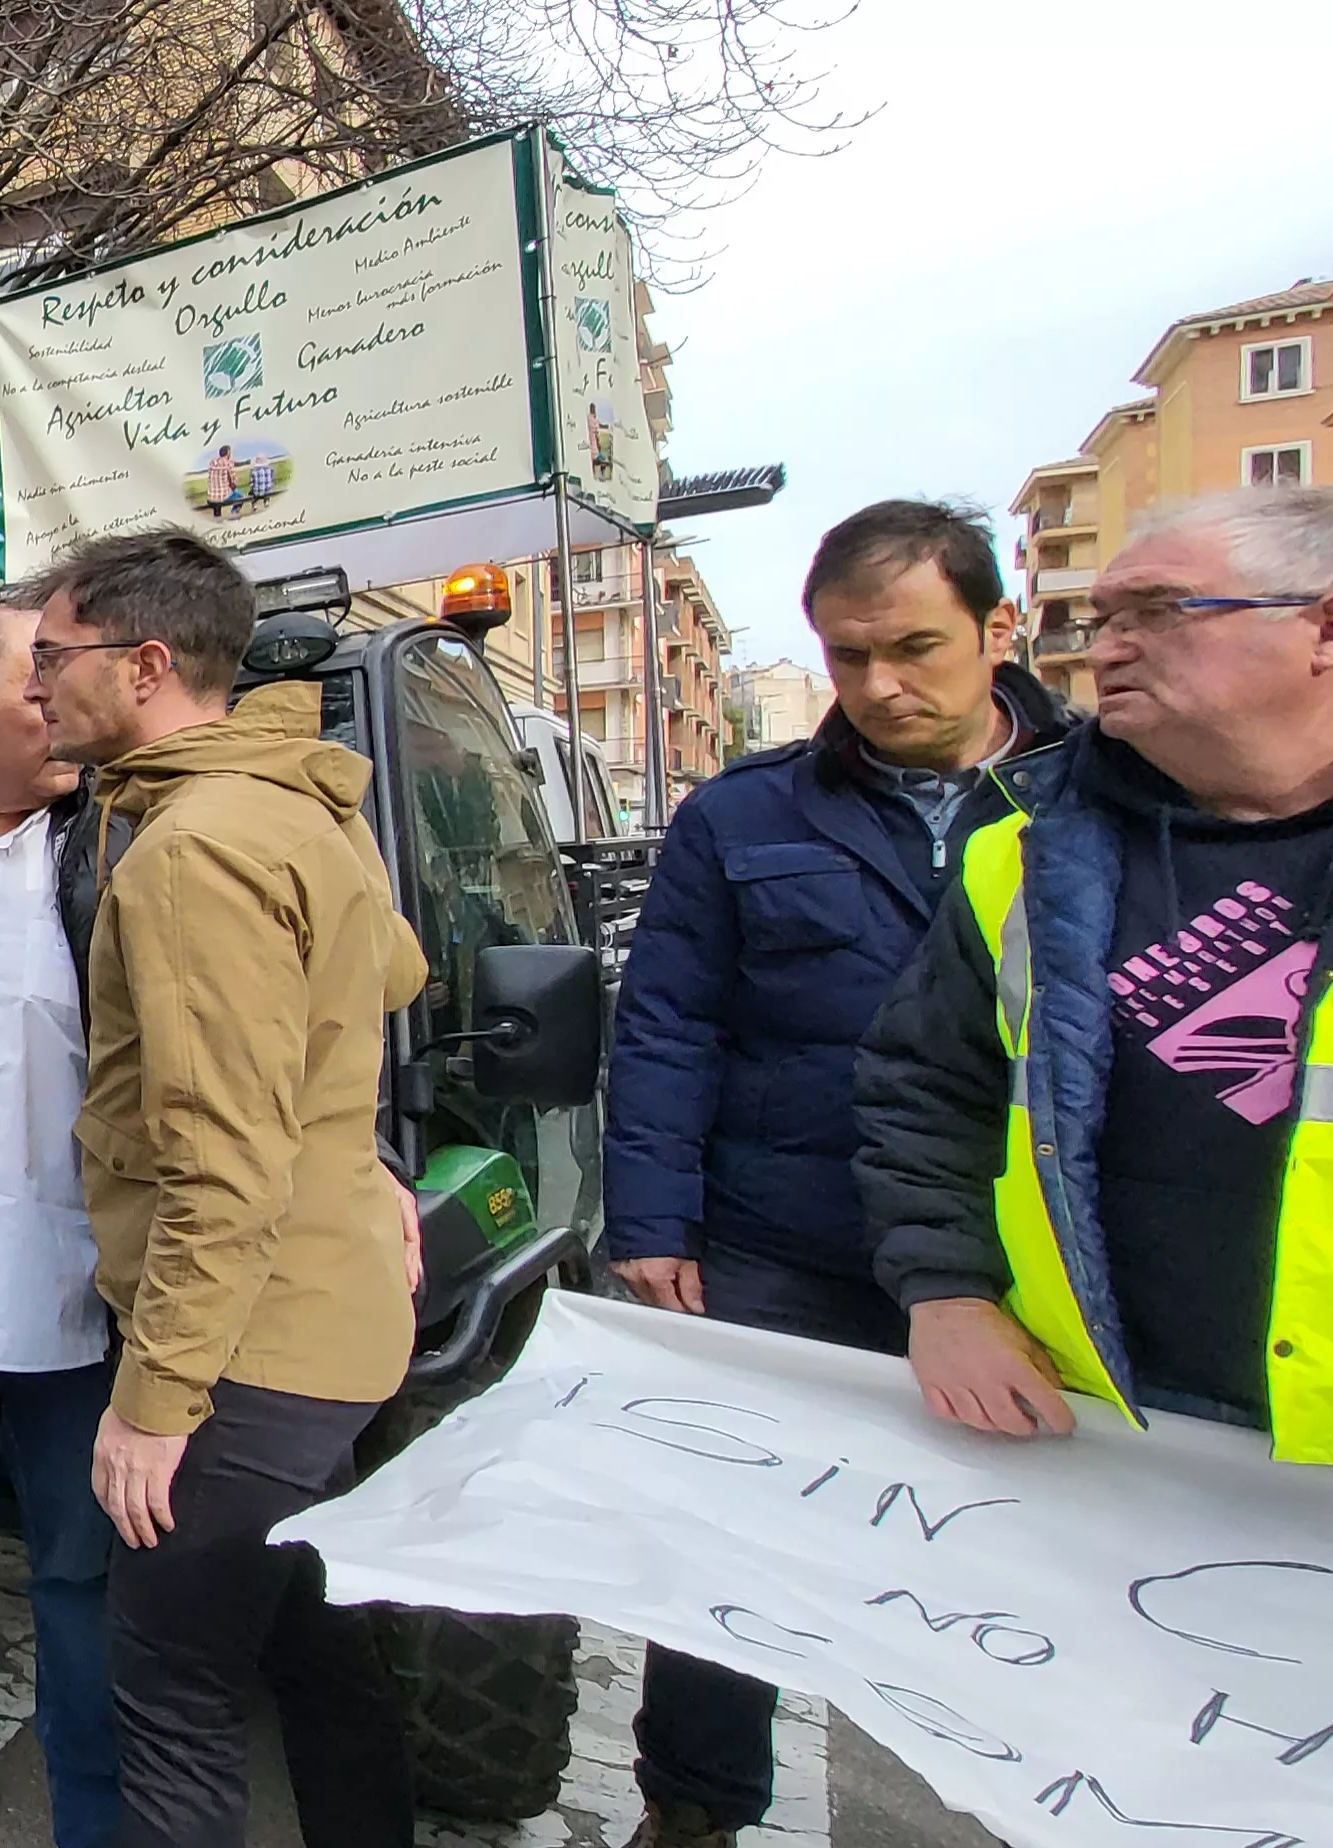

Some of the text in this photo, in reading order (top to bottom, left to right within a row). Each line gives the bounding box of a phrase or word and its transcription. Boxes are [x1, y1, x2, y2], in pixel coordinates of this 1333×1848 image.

[42, 186, 443, 329] Respeto y consideración
[354, 216, 471, 274] Medio Ambiente
[308, 270, 434, 323] Menos burocracia
[421, 260, 502, 302] formación
[175, 280, 287, 337] Orgullo
[28, 337, 113, 360] Sostenibilidad
[297, 321, 425, 372] Ganadero
[2, 384, 17, 398] No
[32, 378, 44, 391] la
[122, 356, 166, 377] desleal
[343, 373, 514, 430] Agricultura sostenible
[47, 386, 173, 440] Agricultor
[124, 385, 338, 451] Vida y Futuro
[347, 447, 498, 484] No a la peste social
[408, 433, 482, 454] intensiva
[17, 488, 46, 502] Nadie
[69, 470, 129, 490] alimentos
[26, 530, 59, 546] Apoyo
[865, 1589, 1055, 1666] NO
